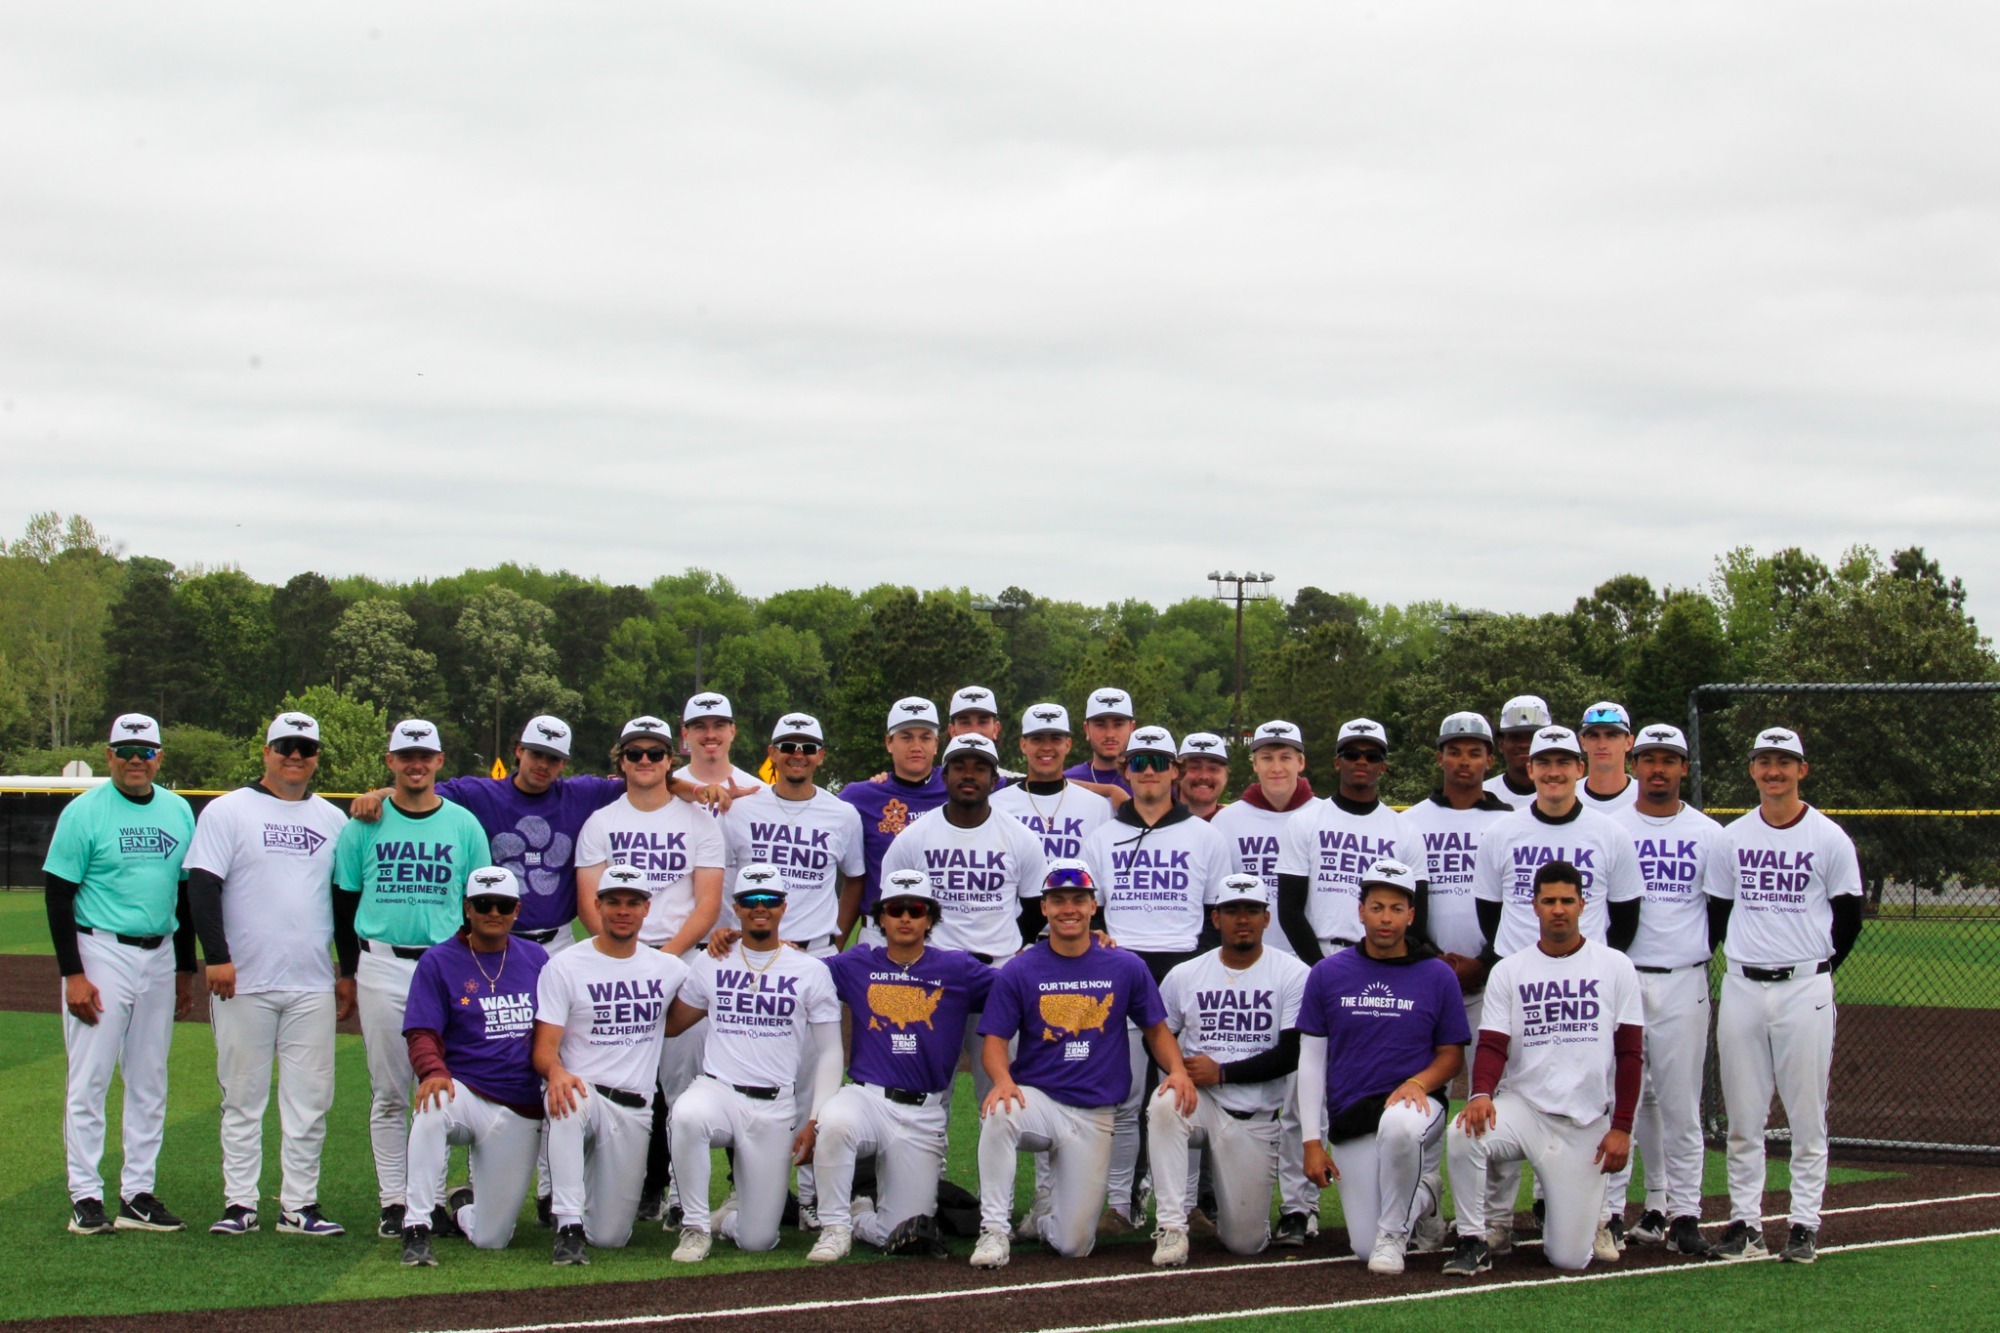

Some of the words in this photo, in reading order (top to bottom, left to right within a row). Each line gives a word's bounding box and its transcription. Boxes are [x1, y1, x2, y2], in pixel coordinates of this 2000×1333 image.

[119, 827, 146, 836] WALK
[146, 827, 158, 836] TO
[264, 823, 290, 832] WALK
[290, 825, 303, 833] TO
[750, 822, 830, 850] WALK
[121, 837, 161, 847] END
[265, 832, 306, 845] END
[609, 832, 686, 850] WALK
[1039, 837, 1080, 858] ND
[1319, 830, 1396, 859] WALK
[1422, 832, 1478, 851] WAL
[376, 841, 454, 864] WALK
[772, 845, 828, 870] END
[924, 849, 1006, 870] WALK
[1513, 846, 1594, 868] WALK
[1634, 839, 1698, 860] ALK
[630, 852, 686, 871] END
[1112, 850, 1190, 870] WALK
[1244, 862, 1256, 870] TO
[1340, 852, 1376, 874] EN
[1444, 853, 1475, 872] EN
[1738, 848, 1814, 872] WALK
[397, 863, 452, 884] END
[778, 867, 825, 881] EIMER'S
[930, 878, 942, 886] TO
[948, 870, 1005, 892] END
[1134, 870, 1189, 890] END
[1517, 874, 1530, 882] TO
[1640, 860, 1696, 882] END
[376, 884, 448, 896] ALZHEIMER'S
[1760, 871, 1810, 892] END
[932, 890, 1002, 902] ALZHEIMER'S
[1110, 892, 1188, 902] ALZHEIMER'S
[716, 970, 799, 996] WALK
[870, 972, 888, 980] OUR
[890, 972, 910, 980] TIME
[1039, 982, 1058, 991] OUR
[1059, 982, 1079, 990] TIME
[1080, 980, 1088, 988] IS
[1089, 980, 1112, 988] NOW
[587, 979, 664, 1002] WALK
[1196, 989, 1274, 1010] WALK
[1518, 979, 1600, 1004] WALK
[478, 993, 532, 1011] WALK
[718, 997, 731, 1005] TO
[736, 992, 796, 1017] END
[1340, 996, 1356, 1007] THE
[1358, 996, 1396, 1008] LONGEST
[1397, 999, 1414, 1010] DAY
[1526, 1011, 1540, 1019] TO
[1544, 1000, 1600, 1022] END
[498, 1008, 534, 1024] END
[615, 1002, 662, 1023] END
[716, 1014, 794, 1027] ALZHEIMER'S
[1202, 1018, 1216, 1026] TO
[1218, 1011, 1272, 1032] END
[1524, 1022, 1598, 1036] ALZHEIMER'S
